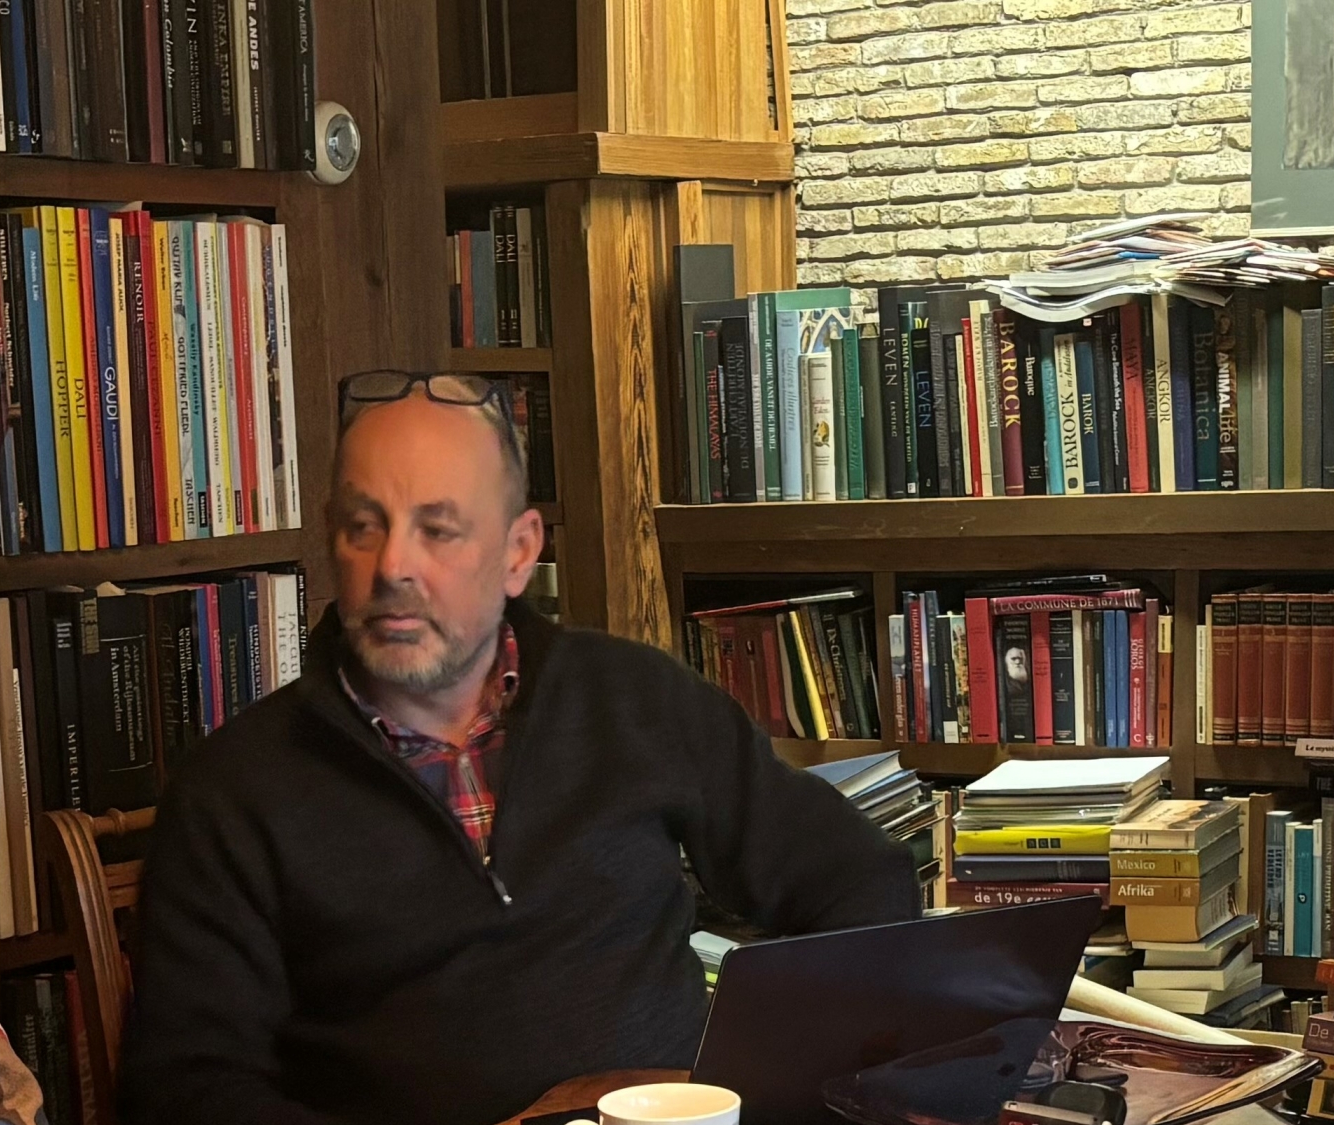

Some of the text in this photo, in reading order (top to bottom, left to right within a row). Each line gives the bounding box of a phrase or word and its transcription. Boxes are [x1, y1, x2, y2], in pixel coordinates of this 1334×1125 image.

[248, 16, 259, 70] ANDES
[133, 261, 144, 323] RENOIR
[882, 328, 898, 387] LEVEN
[901, 333, 909, 369] BOMEN
[999, 321, 1021, 429] BAROCK
[1025, 356, 1036, 396] Baroque
[55, 361, 69, 438] HOPPER
[915, 371, 931, 428] LEVEN
[1082, 393, 1094, 435] BAROK
[1145, 368, 1157, 420] ANGKOR
[1157, 358, 1171, 424] ANGKOR
[1193, 332, 1214, 441] Botanica
[1217, 353, 1237, 443] ANIMAL life
[707, 369, 721, 460] THE HIMALAYAS
[1061, 392, 1079, 469] BAROCK
[184, 478, 195, 525] TASCHEN
[999, 602, 1015, 611] LA
[1017, 598, 1077, 611] COMMUNE
[1079, 598, 1095, 608] DE
[228, 634, 238, 703] Treasures
[1130, 638, 1139, 670] SOROS
[111, 661, 123, 732] Amsterdam
[894, 673, 904, 728] Leven onder glas
[1117, 859, 1156, 872] Mexico
[1117, 883, 1155, 898] Afrika
[974, 893, 1021, 905] de 19e
[1308, 1023, 1329, 1037] De
